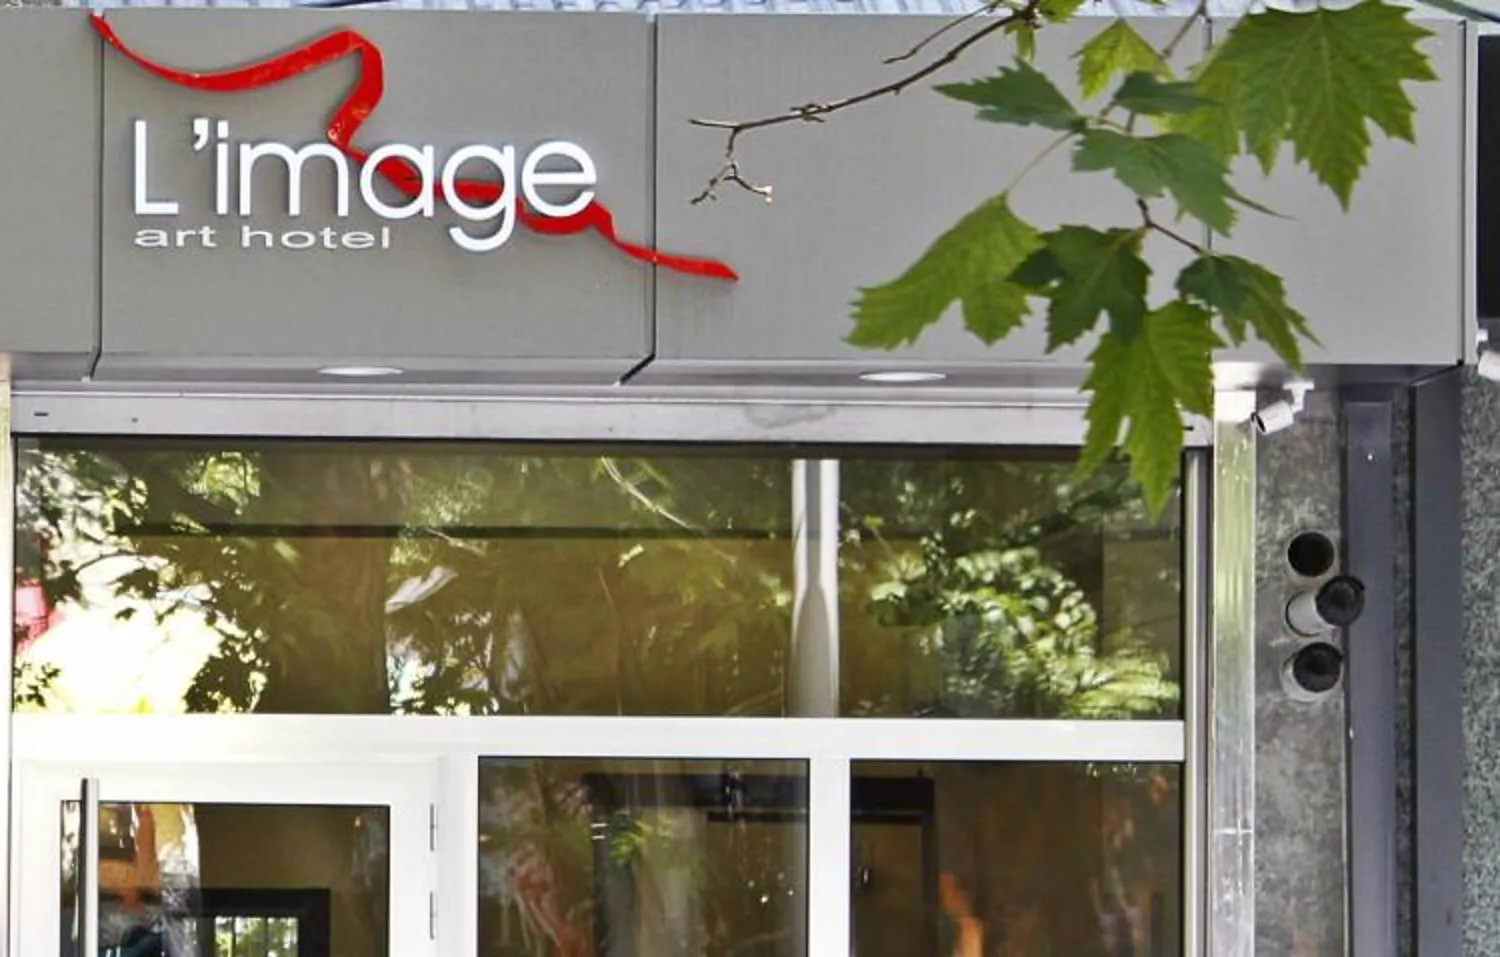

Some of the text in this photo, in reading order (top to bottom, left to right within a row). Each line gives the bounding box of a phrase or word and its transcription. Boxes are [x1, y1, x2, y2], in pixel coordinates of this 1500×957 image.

[133, 118, 597, 252] L'image
[134, 225, 390, 249] art hotel
